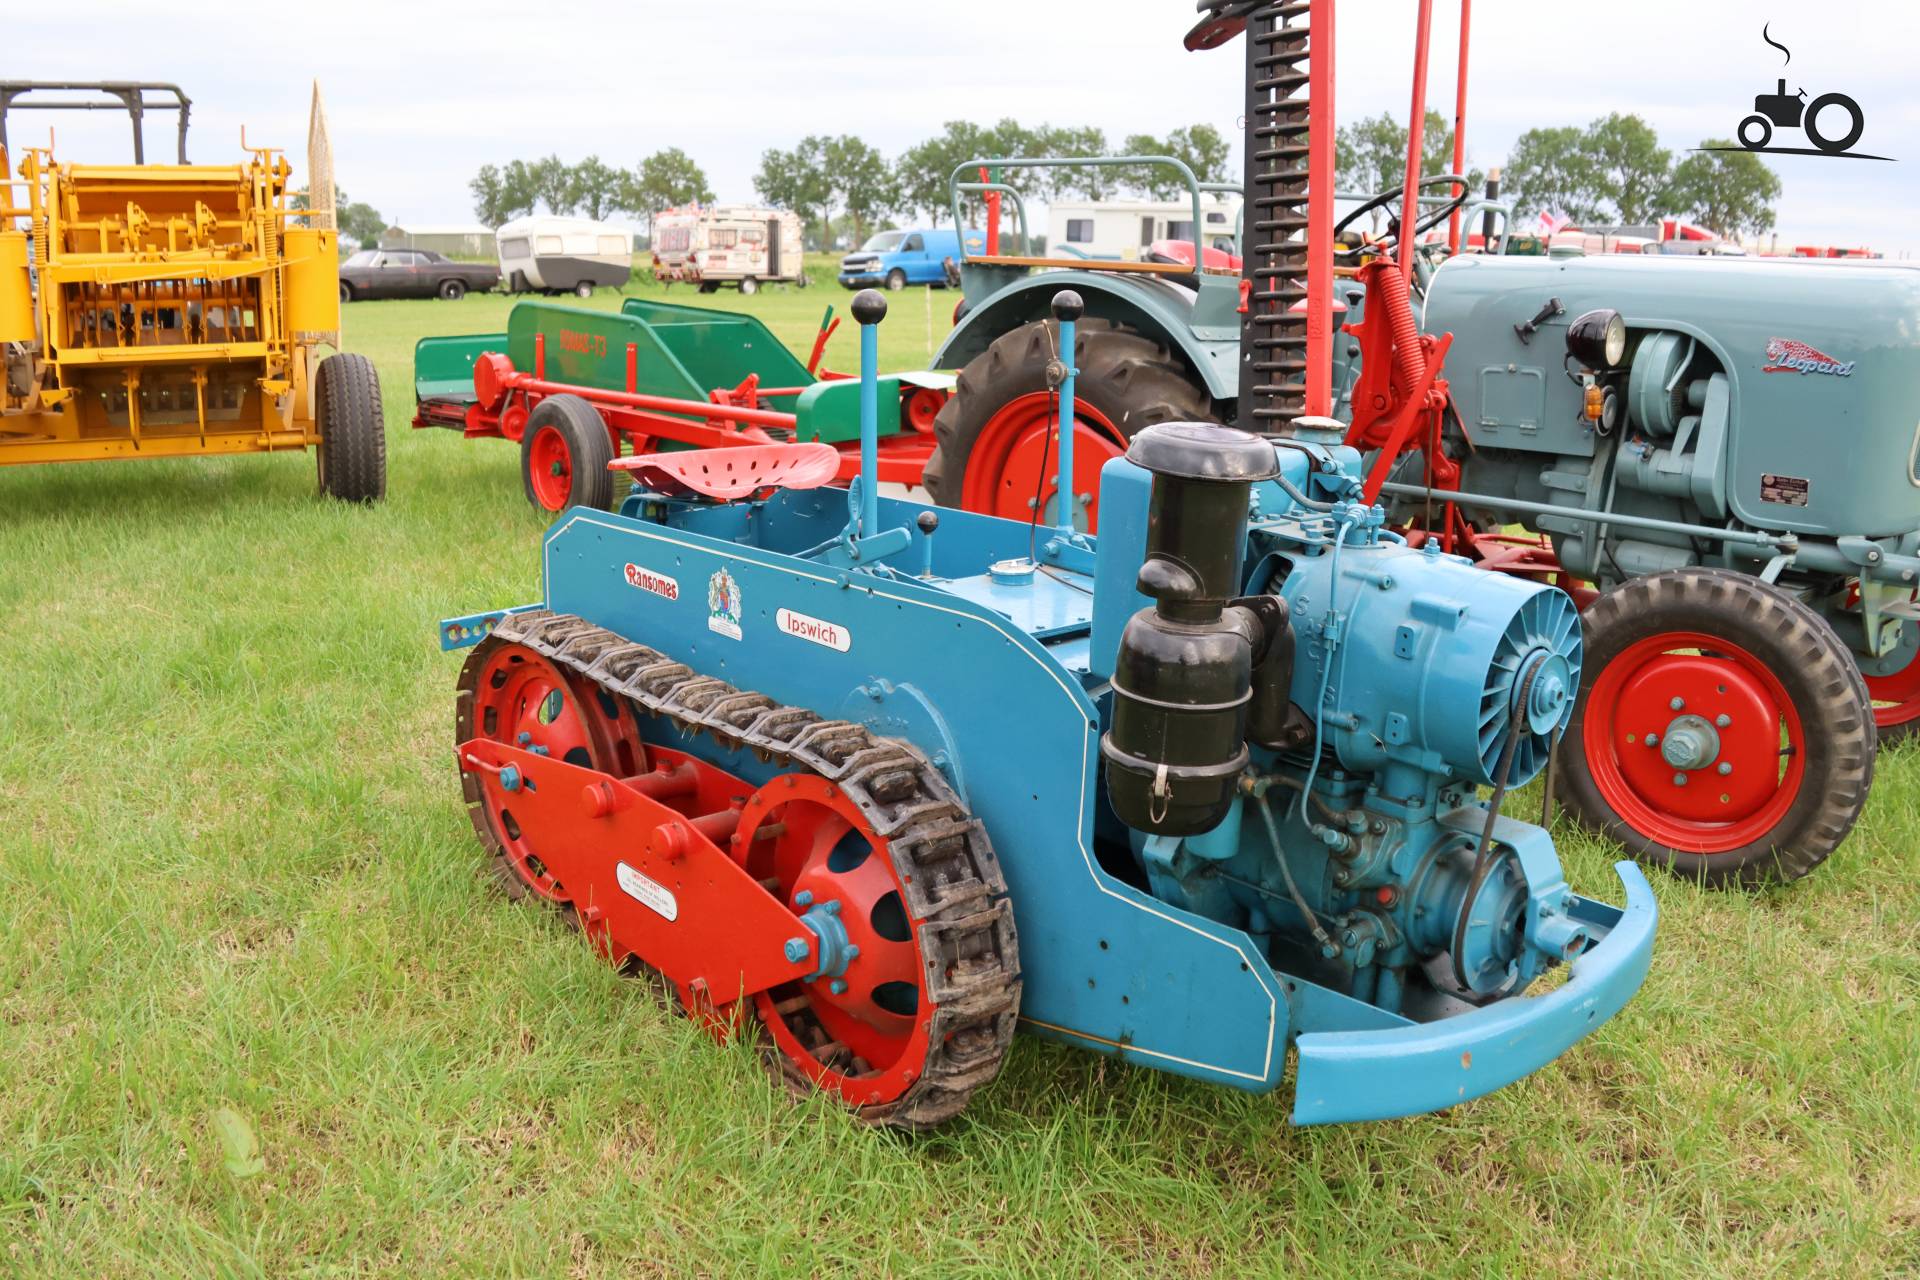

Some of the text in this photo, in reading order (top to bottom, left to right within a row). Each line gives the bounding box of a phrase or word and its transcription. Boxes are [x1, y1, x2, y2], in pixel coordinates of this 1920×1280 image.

[1777, 351, 1856, 376] Leopard
[626, 563, 677, 600] Ransomes
[787, 612, 838, 645] Ipswich
